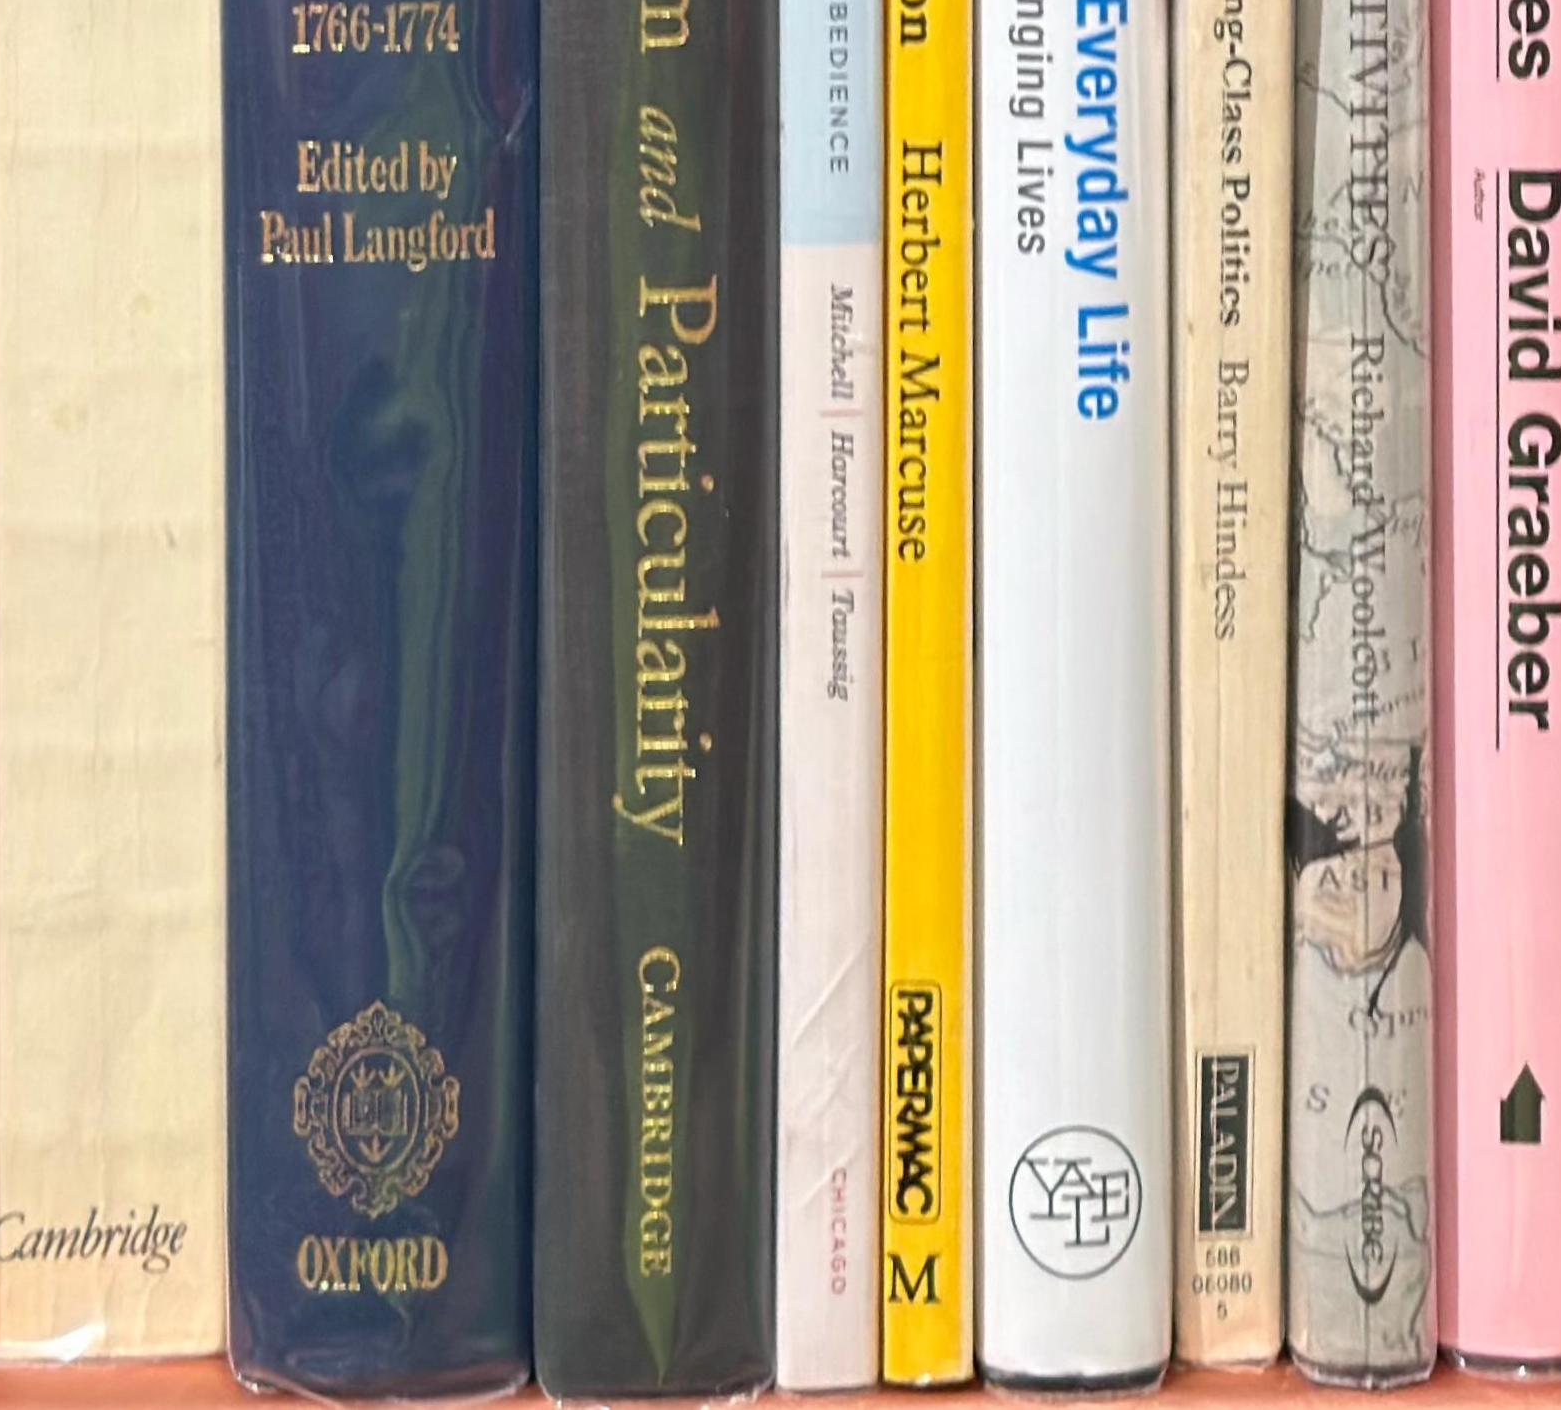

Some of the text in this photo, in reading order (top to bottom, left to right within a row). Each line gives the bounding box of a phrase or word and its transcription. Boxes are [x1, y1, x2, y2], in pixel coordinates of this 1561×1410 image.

[292, 3, 460, 53] 1766-1774
[296, 140, 409, 192] Edited
[1017, 139, 1053, 255] Lives
[261, 208, 496, 271] Paul Langford
[901, 141, 942, 335] Herbert
[1218, 174, 1252, 327] Politics
[829, 284, 855, 398] Mitchell
[1076, 304, 1130, 420] Life
[899, 349, 941, 563] Marcuse
[1207, 359, 1250, 471] Barry
[1351, 334, 1385, 505] Richard
[612, 275, 720, 845] Particularity
[1213, 482, 1248, 640] Hindess
[1350, 513, 1385, 725] Woolcott
[637, 945, 681, 1275] CAMBRIDGE
[1209, 1060, 1239, 1231] PALADIN
[297, 1233, 448, 1293] OXFORD
[831, 1169, 846, 1296] CHICAGO
